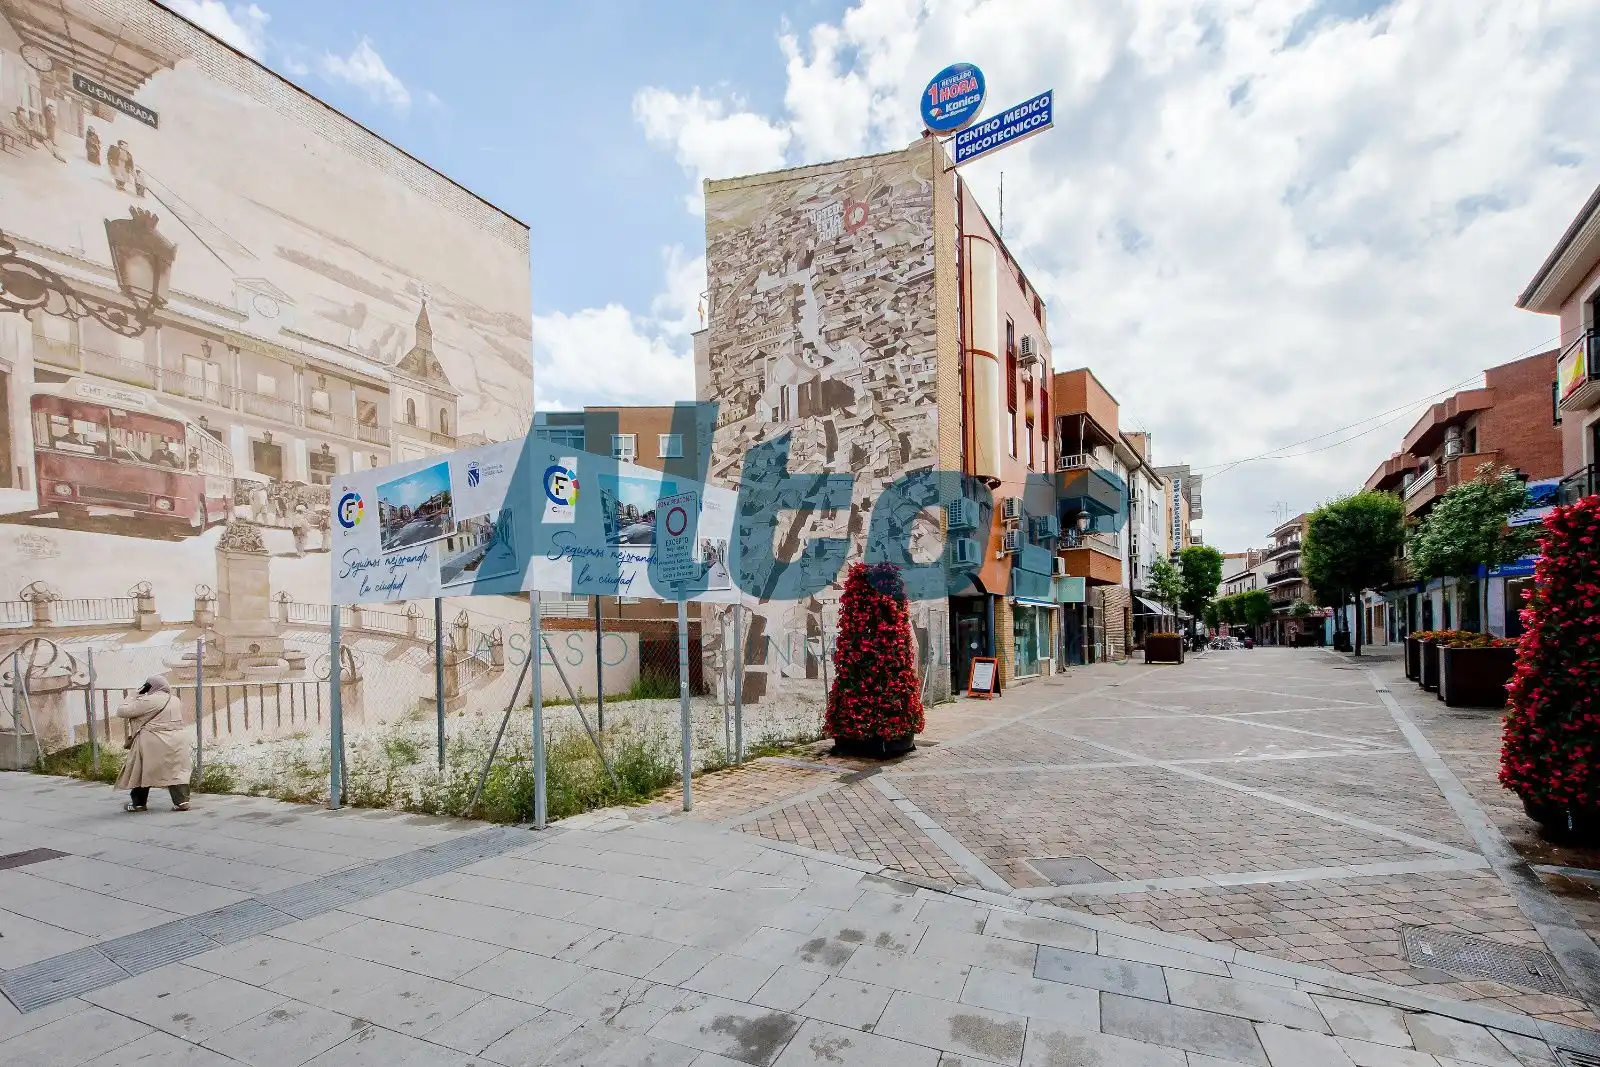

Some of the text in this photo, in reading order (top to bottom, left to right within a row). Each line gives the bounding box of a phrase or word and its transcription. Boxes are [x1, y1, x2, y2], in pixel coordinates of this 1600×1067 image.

[928, 77, 978, 105] 1 HORA
[941, 71, 972, 88] REVELADO
[79, 80, 156, 124] FUENLABRADA
[945, 94, 980, 113] Konica
[957, 118, 1000, 145] CENTRO
[1003, 96, 1050, 126] MEDICO
[958, 111, 1049, 158] PSICOTECNICOS
[546, 530, 604, 562] Seguimos
[665, 537, 689, 547] EXCEPTO
[359, 572, 408, 600] la ciudad
[577, 564, 637, 594] la ciudad
